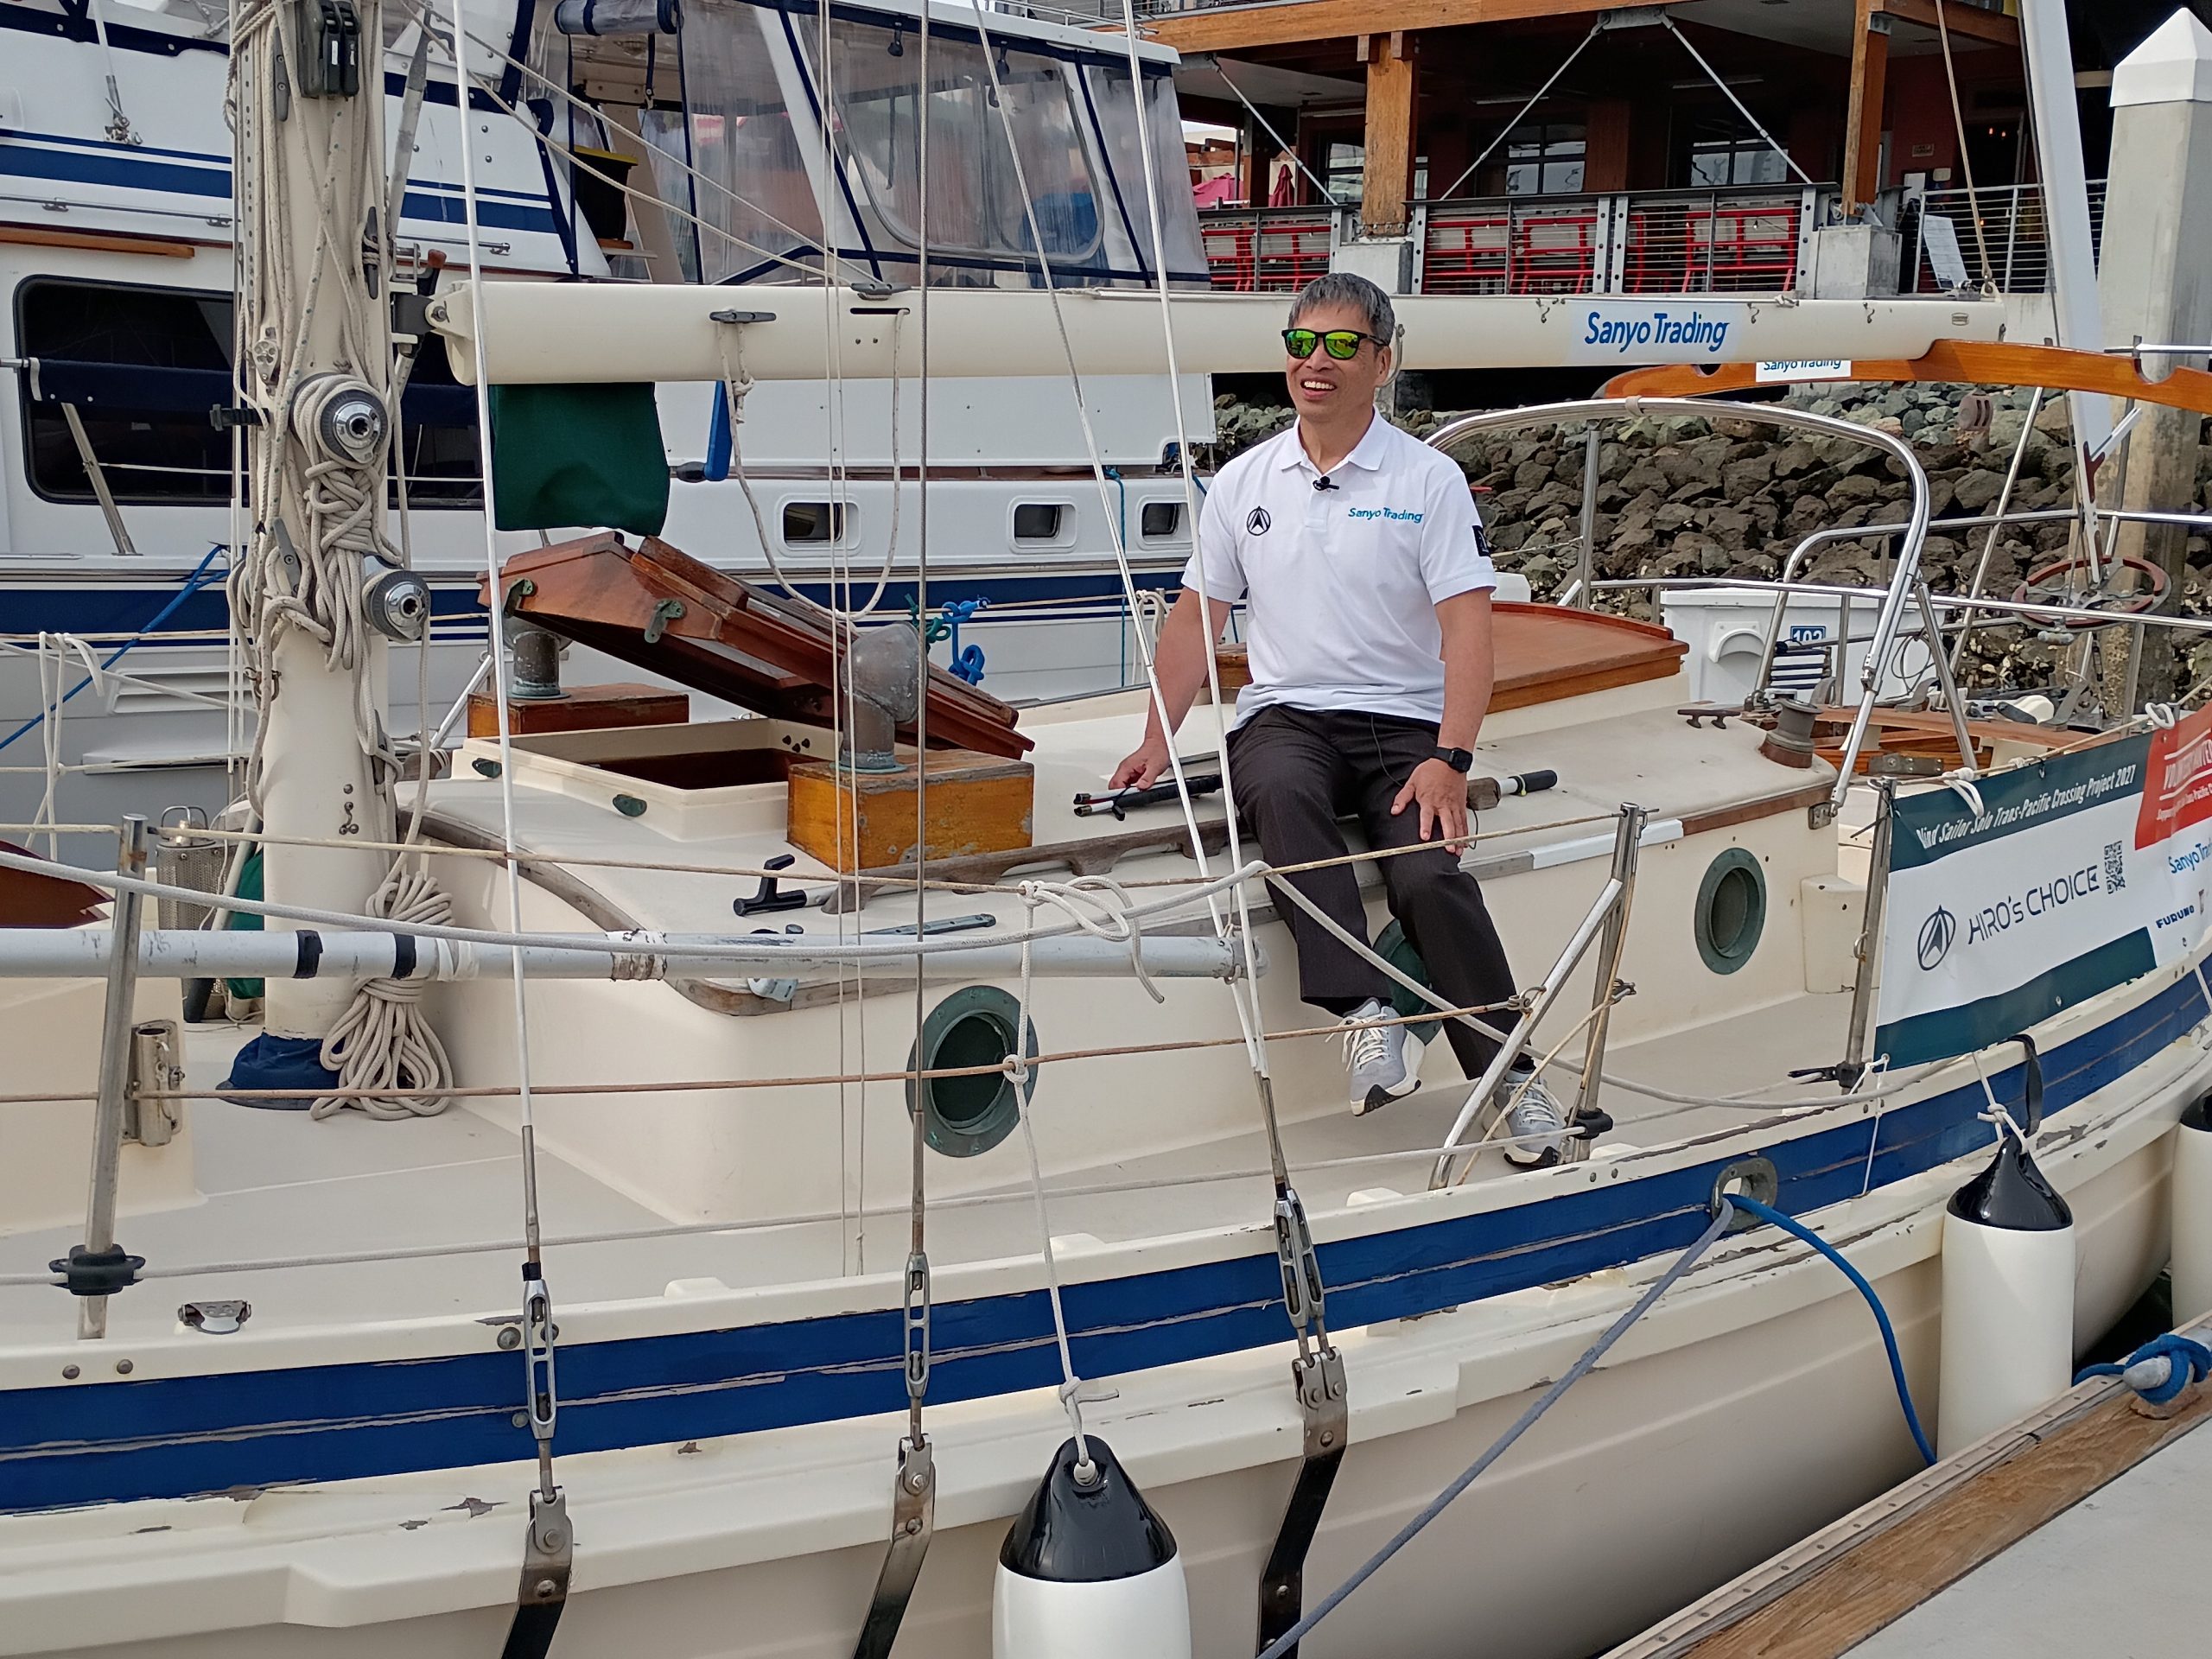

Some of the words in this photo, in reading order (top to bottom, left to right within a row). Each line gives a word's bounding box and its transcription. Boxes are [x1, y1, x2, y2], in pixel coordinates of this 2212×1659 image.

[1585, 312, 1650, 353] Sanyo
[1654, 311, 1730, 353] Trading
[1348, 507, 1381, 520] Sanyo
[1383, 506, 1424, 524] Trading
[1939, 819, 1971, 842] Sailor
[1970, 810, 1993, 834] Solo
[1993, 792, 2052, 828] Trans-Pacific
[2051, 783, 2087, 809] Crossing
[2086, 772, 2115, 798] Project
[2115, 765, 2136, 787] 2027
[2168, 851, 2200, 874] Sanyo
[1968, 895, 2024, 944] HIRO's
[2026, 865, 2100, 916] CHOICE
[2156, 905, 2195, 929] FURUNO
